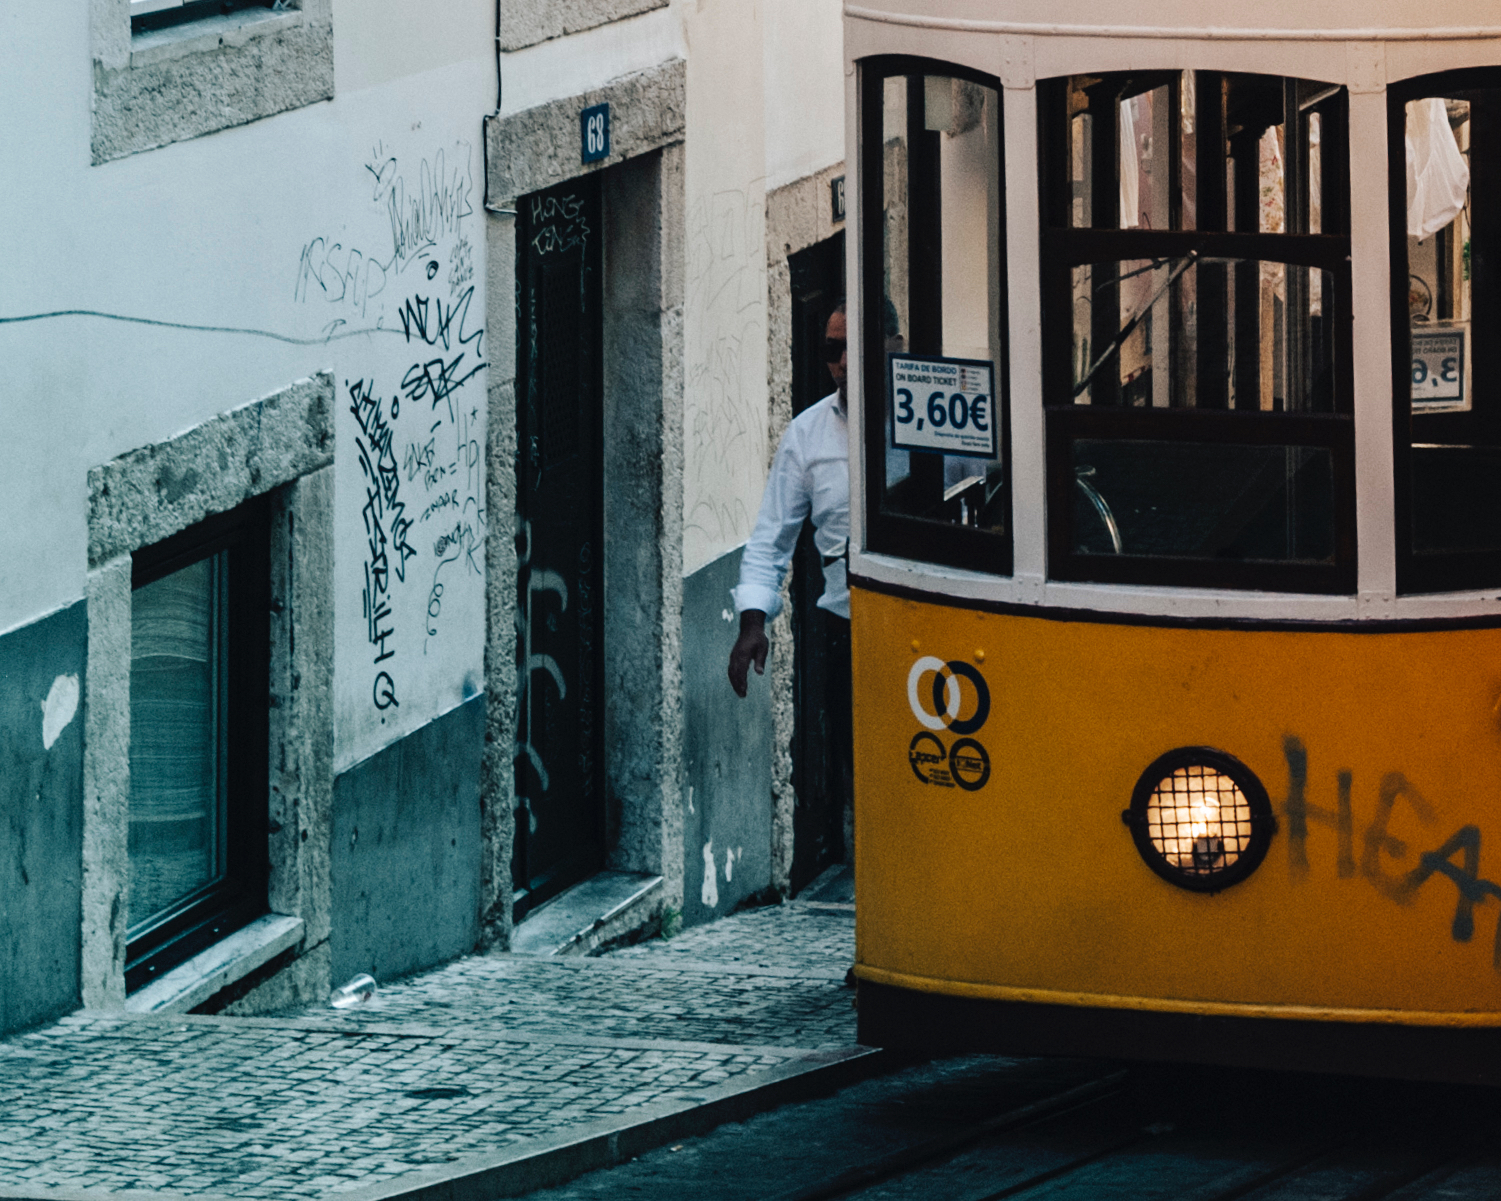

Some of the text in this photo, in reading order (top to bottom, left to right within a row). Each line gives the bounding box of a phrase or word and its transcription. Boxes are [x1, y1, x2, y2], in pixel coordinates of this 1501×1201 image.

[587, 113, 605, 155] 68
[895, 362, 957, 375] TARIFA DE BORDO
[895, 373, 906, 381] ON
[907, 374, 932, 384] BOARD
[933, 377, 957, 387] TICKET
[896, 388, 989, 432] 3,60€
